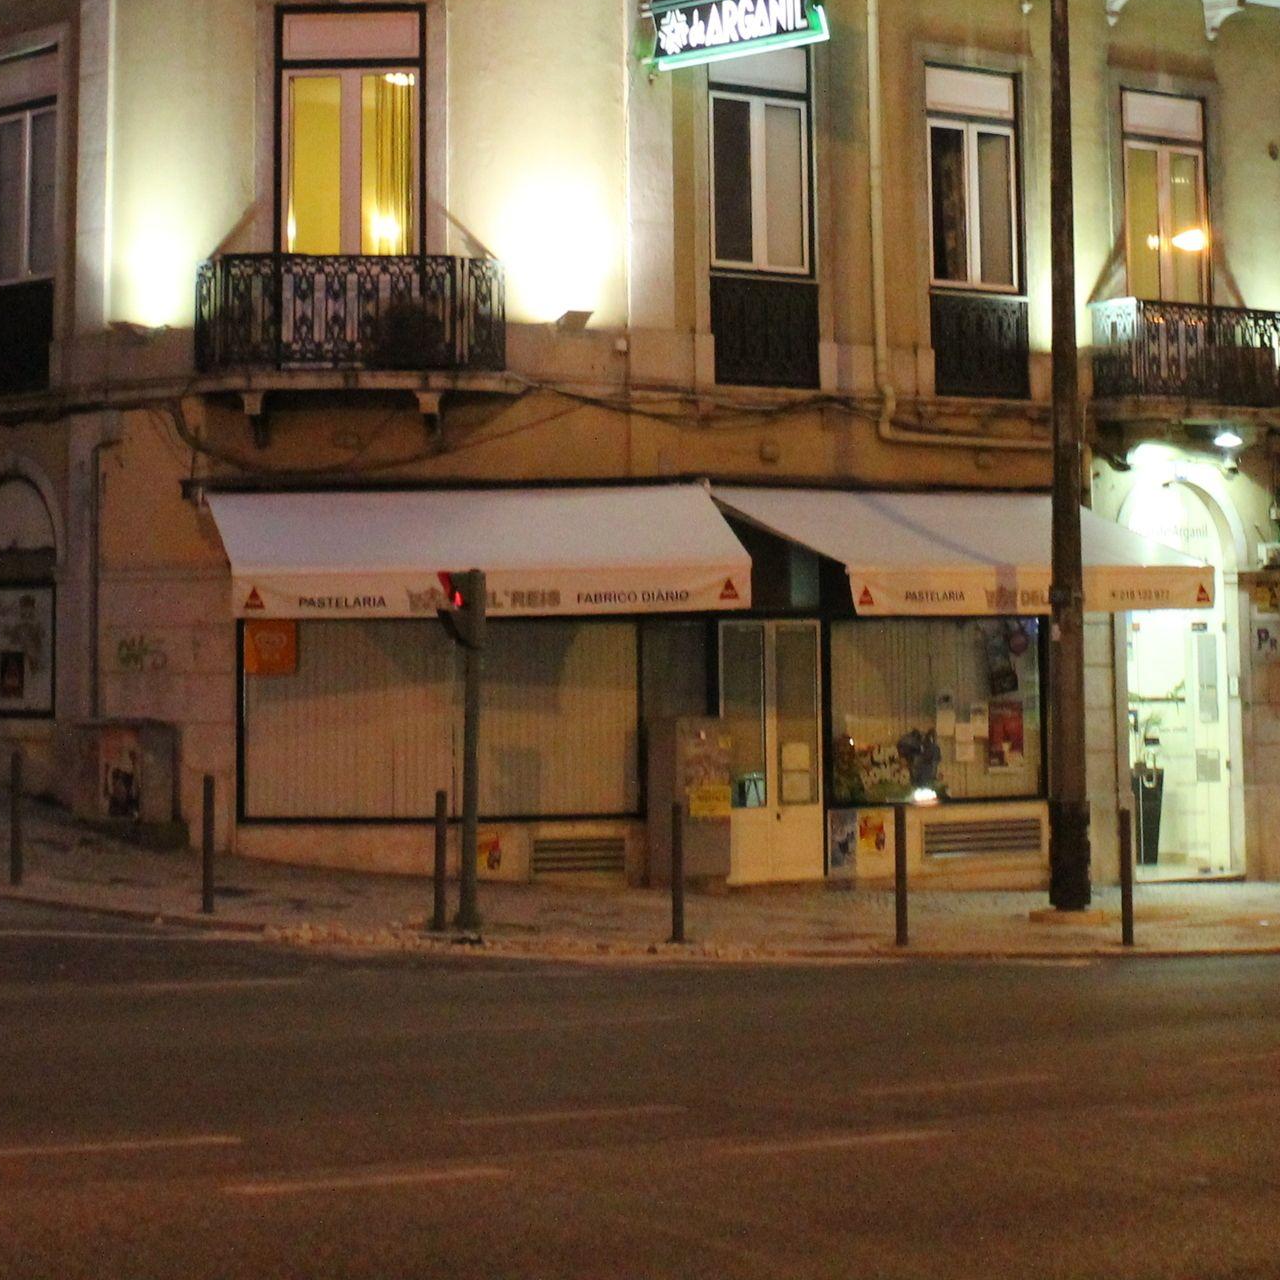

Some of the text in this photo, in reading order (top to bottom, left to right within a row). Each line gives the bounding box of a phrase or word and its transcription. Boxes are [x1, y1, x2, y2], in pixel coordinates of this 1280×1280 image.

[298, 595, 387, 609] PASTELARIA
[576, 590, 638, 605] FABRICO
[904, 590, 966, 603] PASTELARIA
